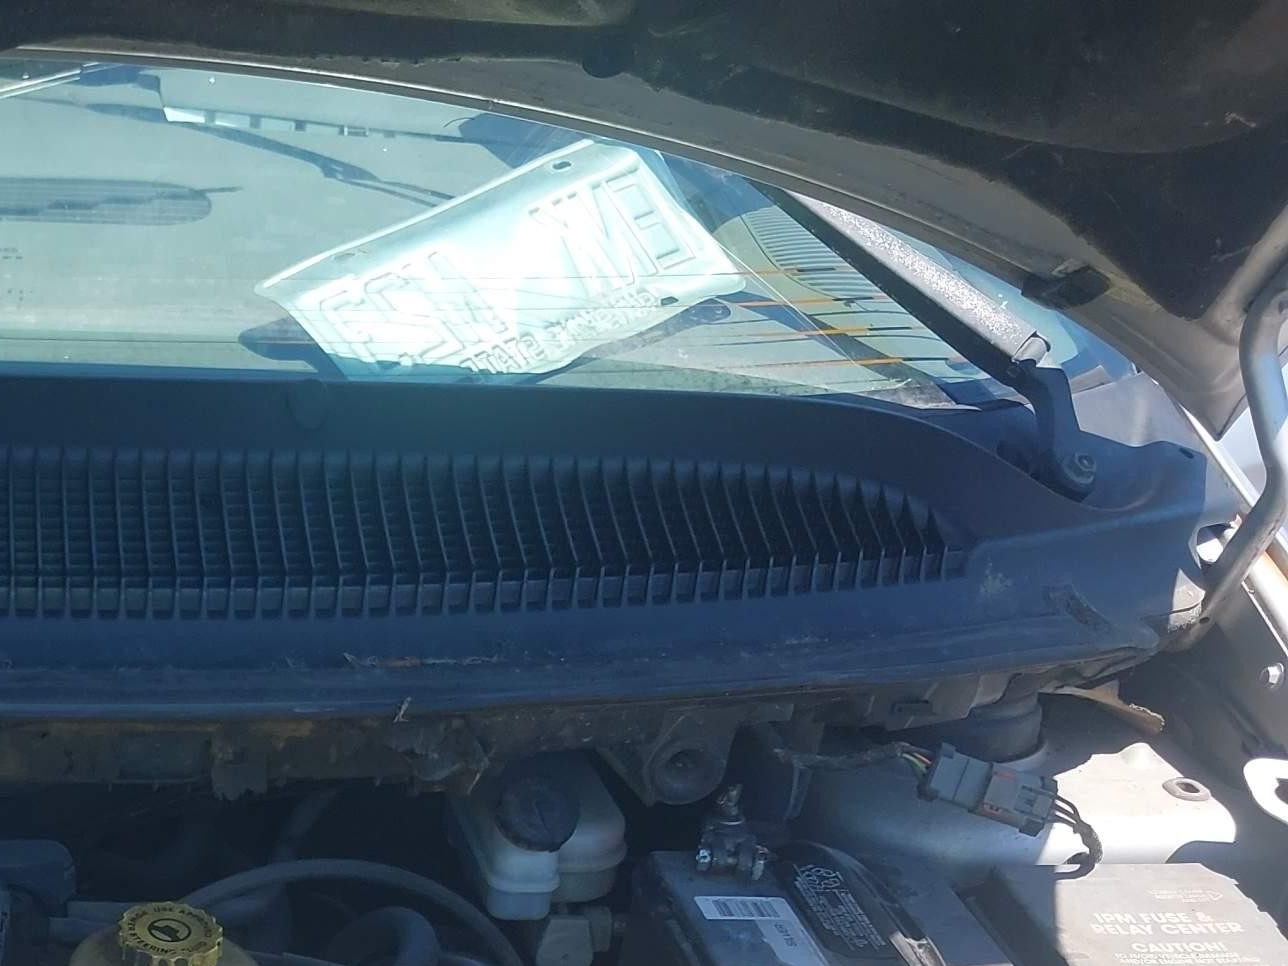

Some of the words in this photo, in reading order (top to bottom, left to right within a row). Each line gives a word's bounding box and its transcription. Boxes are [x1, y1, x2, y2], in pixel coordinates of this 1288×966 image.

[1139, 912, 1192, 924] FUSE
[1090, 924, 1155, 935] RELAY
[1160, 922, 1246, 935] CENTER
[1132, 942, 1228, 953] CAUTION!
